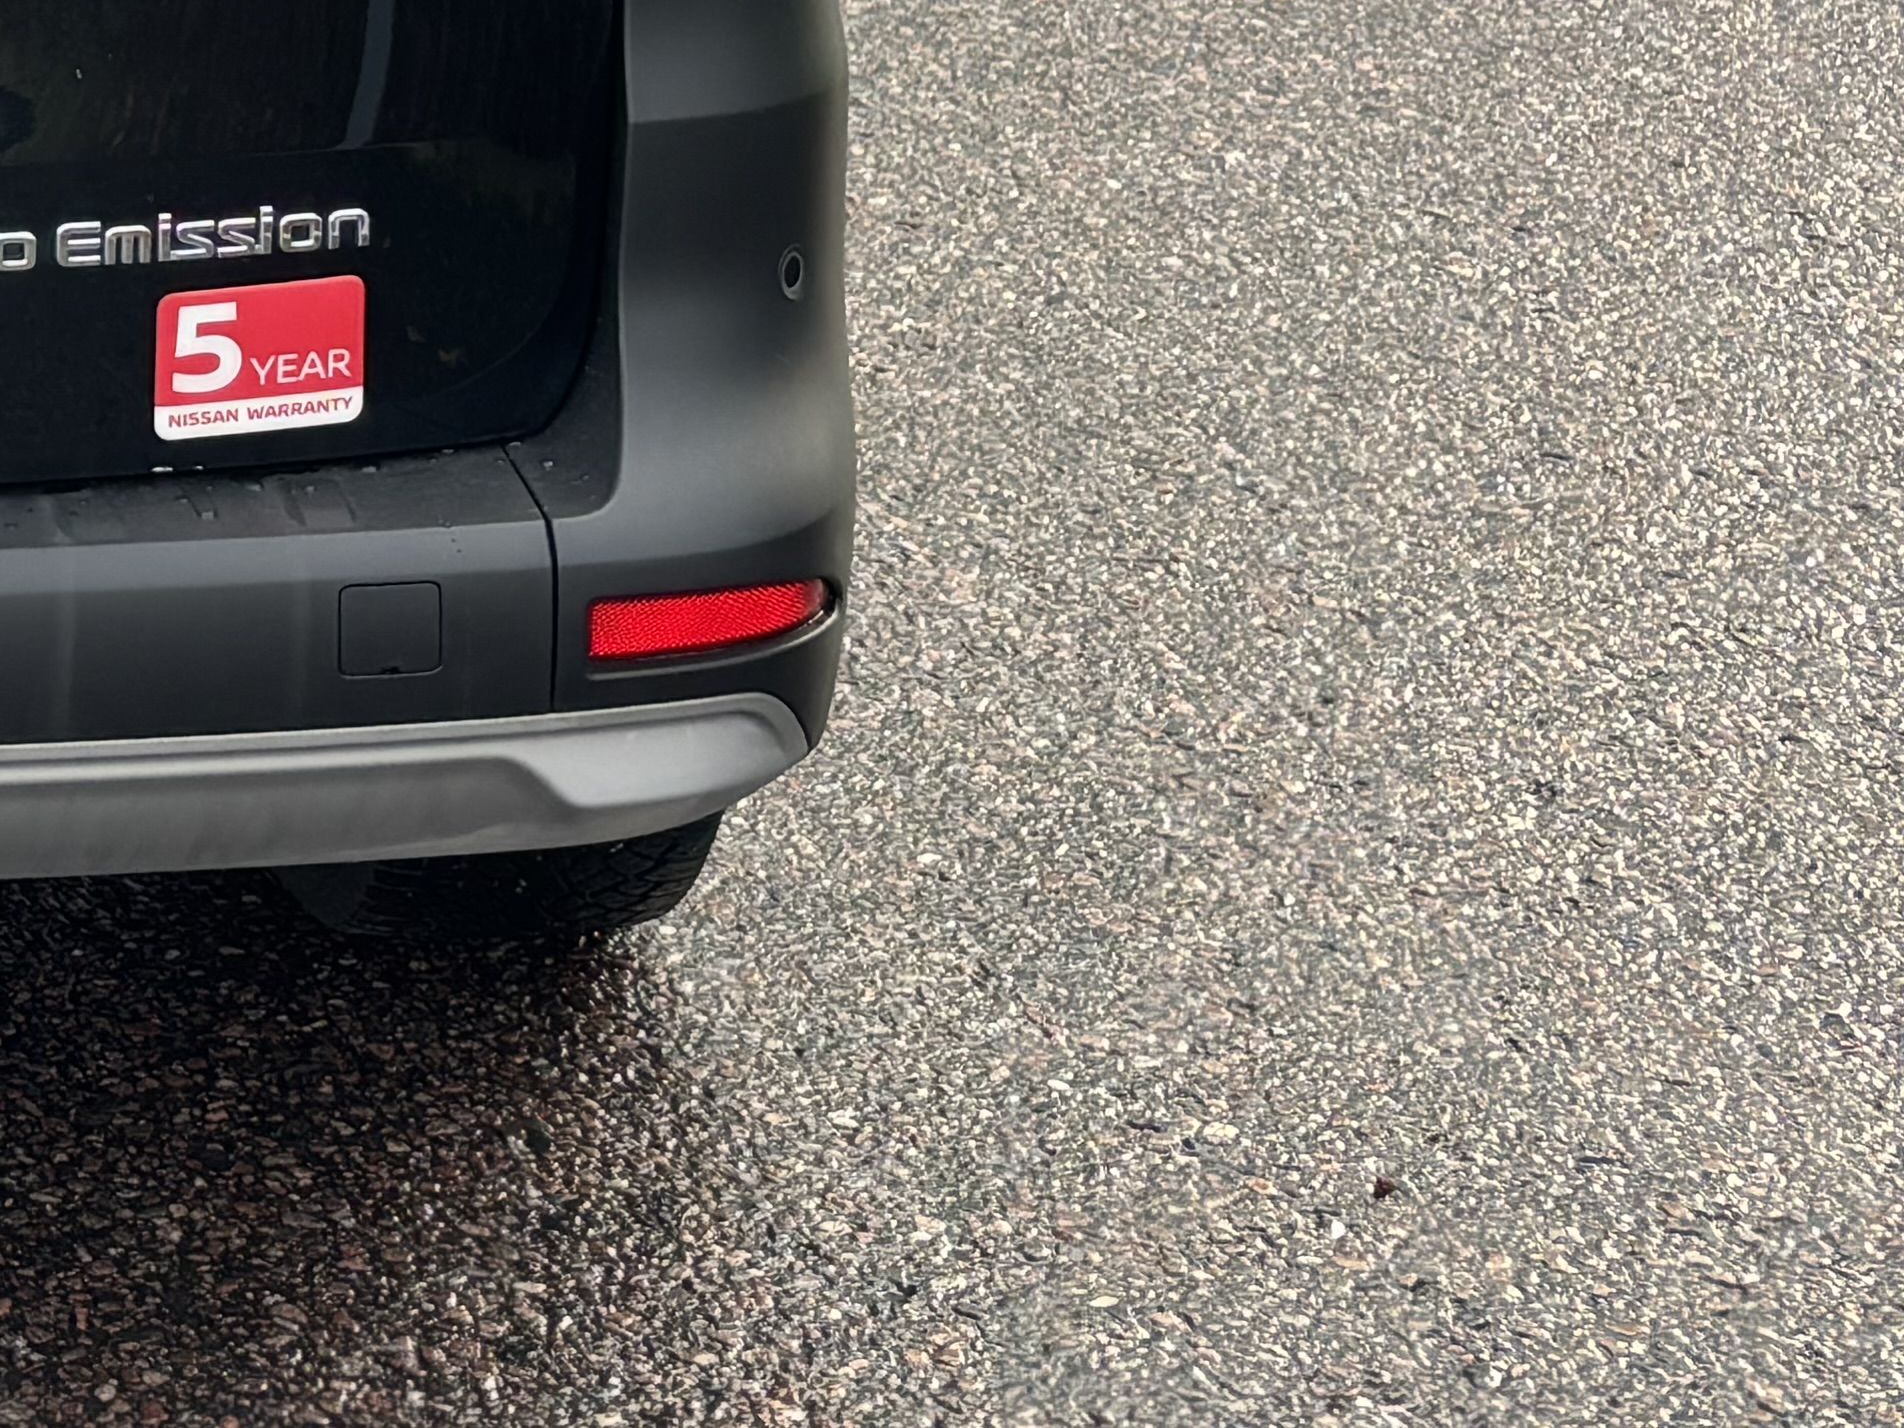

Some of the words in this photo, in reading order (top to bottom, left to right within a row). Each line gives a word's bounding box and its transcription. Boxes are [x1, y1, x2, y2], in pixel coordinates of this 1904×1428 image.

[171, 300, 243, 394] 5
[249, 348, 352, 386] YEAR
[167, 408, 240, 429] NISSAN
[246, 396, 354, 421] WARRANTY
